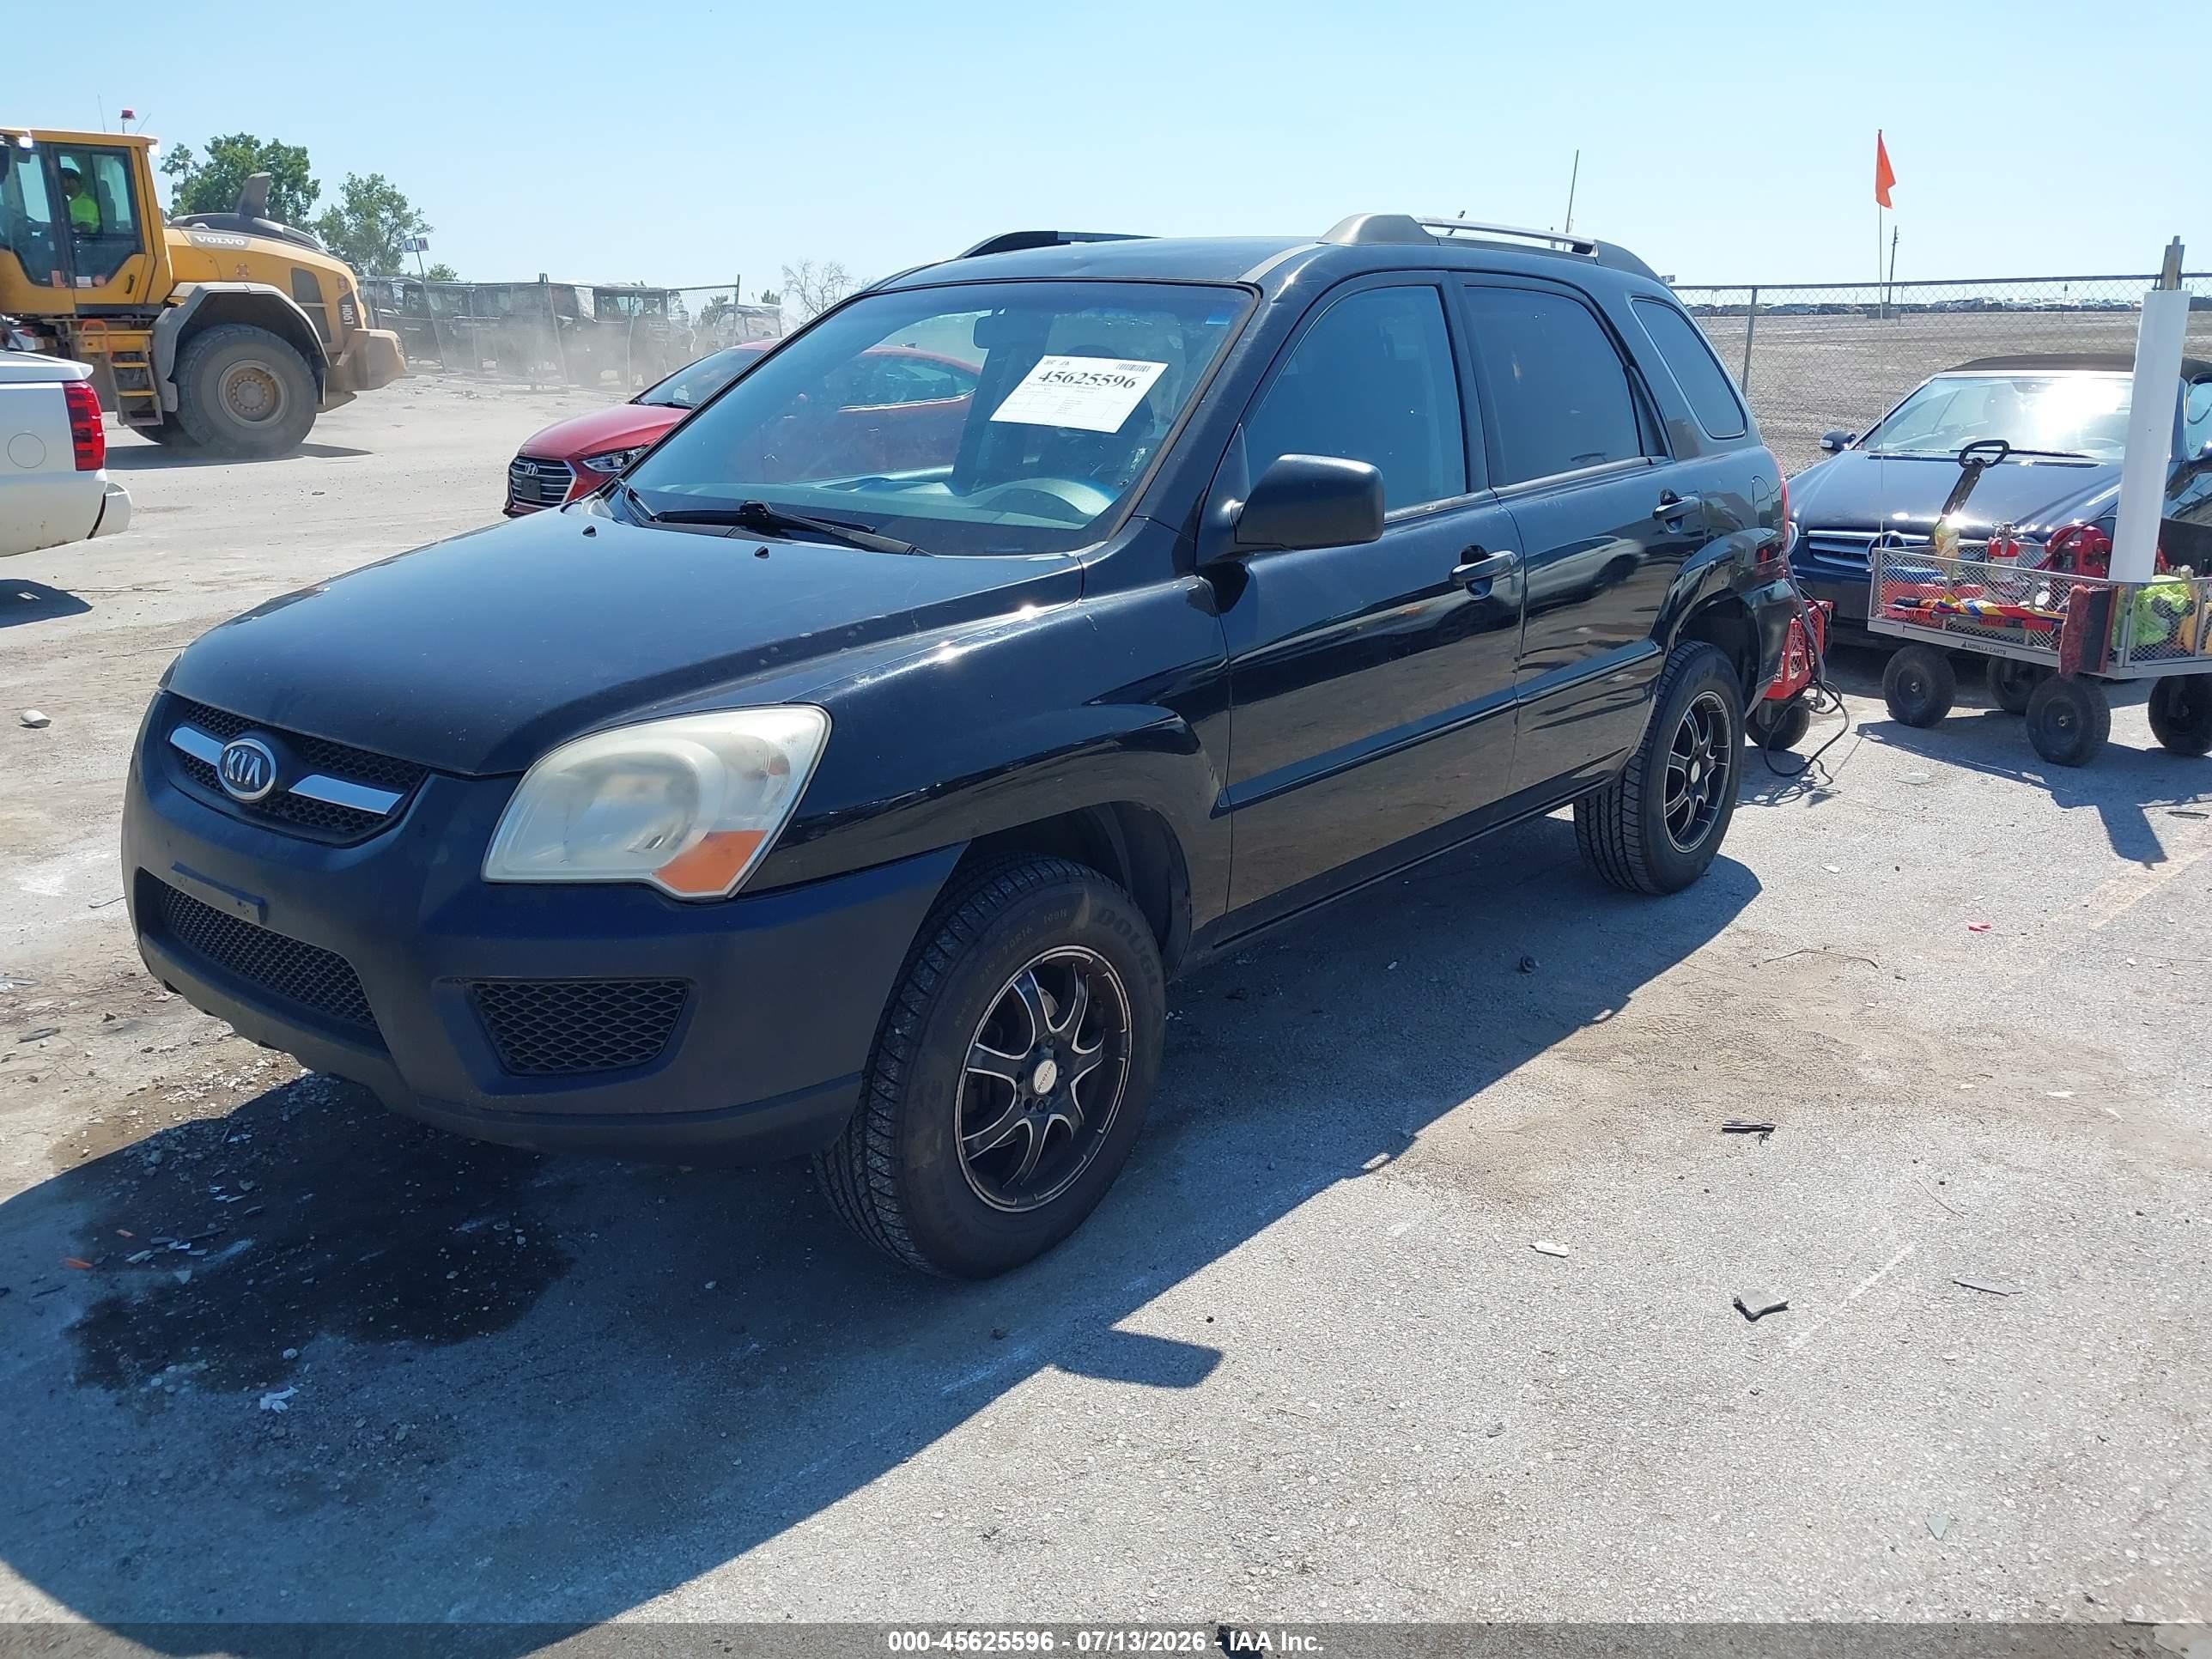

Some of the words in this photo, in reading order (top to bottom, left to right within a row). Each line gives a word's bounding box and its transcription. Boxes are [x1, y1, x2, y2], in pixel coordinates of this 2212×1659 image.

[195, 235, 245, 246] VOLVO
[342, 304, 355, 325] L90H
[1038, 370, 1141, 389] 45625596
[224, 749, 262, 789] KIA
